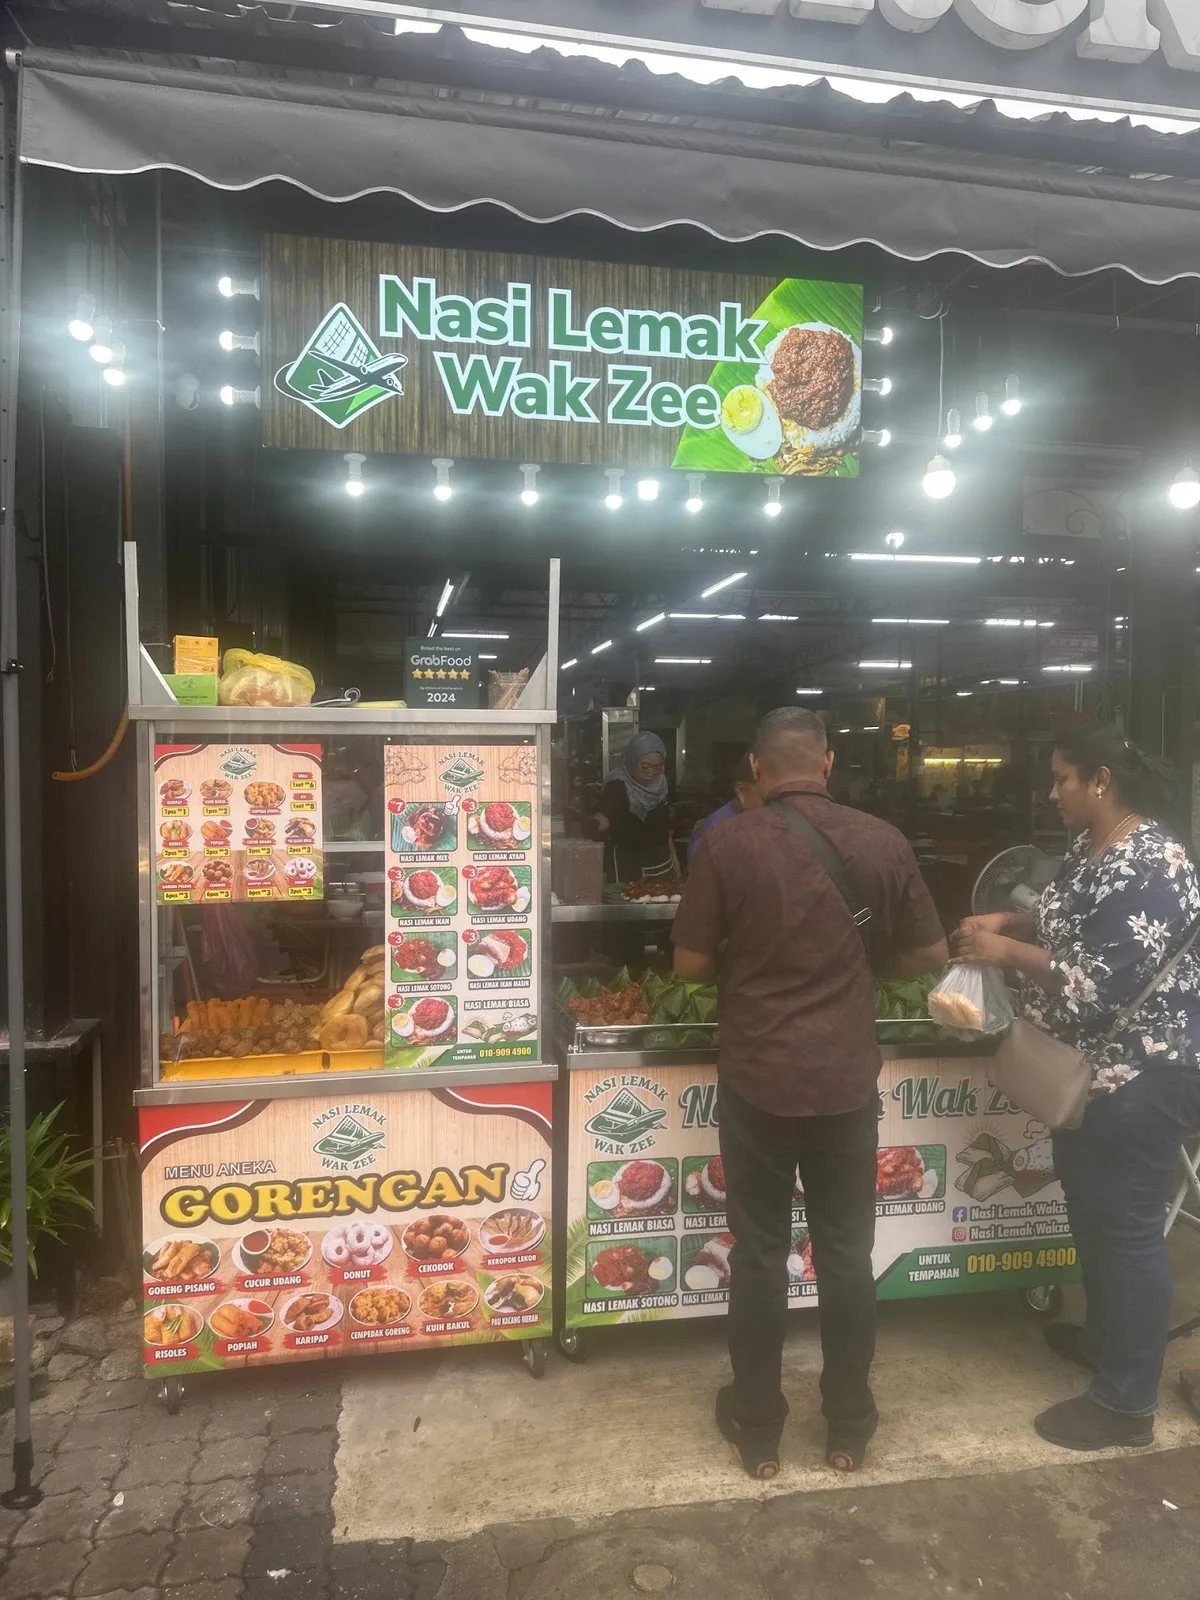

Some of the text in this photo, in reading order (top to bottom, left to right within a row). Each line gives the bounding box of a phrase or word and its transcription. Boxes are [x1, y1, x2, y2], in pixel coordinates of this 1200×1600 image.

[380, 273, 770, 365] Nasi Lemak
[432, 351, 723, 429] Wak Zee
[410, 654, 472, 666] GrabFood
[427, 692, 456, 703] 2024
[219, 747, 258, 759] NASI LEMAK
[438, 751, 486, 767] NASI LEMAK
[224, 772, 239, 780] WAK
[443, 783, 479, 794] WAK ZEE
[415, 854, 435, 862] LEMAK
[430, 983, 451, 991] SOTONG
[465, 999, 529, 1010] NASI LEMAK BIASA
[479, 1048, 510, 1057] 010-909
[512, 1047, 532, 1056] 4900
[583, 1075, 670, 1104] NASI LEMAK
[892, 1075, 979, 1120] Wak
[312, 1103, 388, 1131] NASI LEMAK
[594, 1135, 656, 1155] WAK ZEE
[321, 1152, 377, 1172] WAK ZEE
[164, 1159, 276, 1180] MENU ANEKA
[161, 1163, 509, 1227] GORENGAN
[875, 1201, 944, 1216] SI LEMAK UDANG
[971, 1201, 1067, 1220] Nasi Lemak Wakz
[685, 1215, 728, 1228] NASI LEM
[791, 1210, 799, 1222] SI
[589, 1218, 674, 1235] NASI LEMAK BIASA
[970, 1220, 1070, 1240] Nasi Lemak Wakze
[487, 1254, 537, 1265] KEROPOK LEKOR
[918, 1247, 1077, 1274] UNTUK 010-909 4900
[418, 1262, 455, 1273] CEKODOK
[343, 1270, 371, 1280] DONUT
[908, 1267, 960, 1282] TEMPAHAN
[148, 1282, 216, 1296] GORENG PISANG
[244, 1276, 302, 1289] CUCUR UDANG
[787, 1284, 818, 1296] ASI LEM
[583, 1295, 678, 1314] NASI LEMAK SOTONG
[683, 1295, 699, 1305] NASI
[700, 1292, 724, 1303] LEMAK
[425, 1320, 471, 1332] KUIH BAKUL
[491, 1313, 539, 1326] PAU KACANG MERAH
[350, 1326, 411, 1339] CEMPEDAK GORENG
[227, 1341, 258, 1351] POPIAH
[295, 1334, 329, 1345] KARIPAP
[154, 1348, 187, 1359] RISOLES
